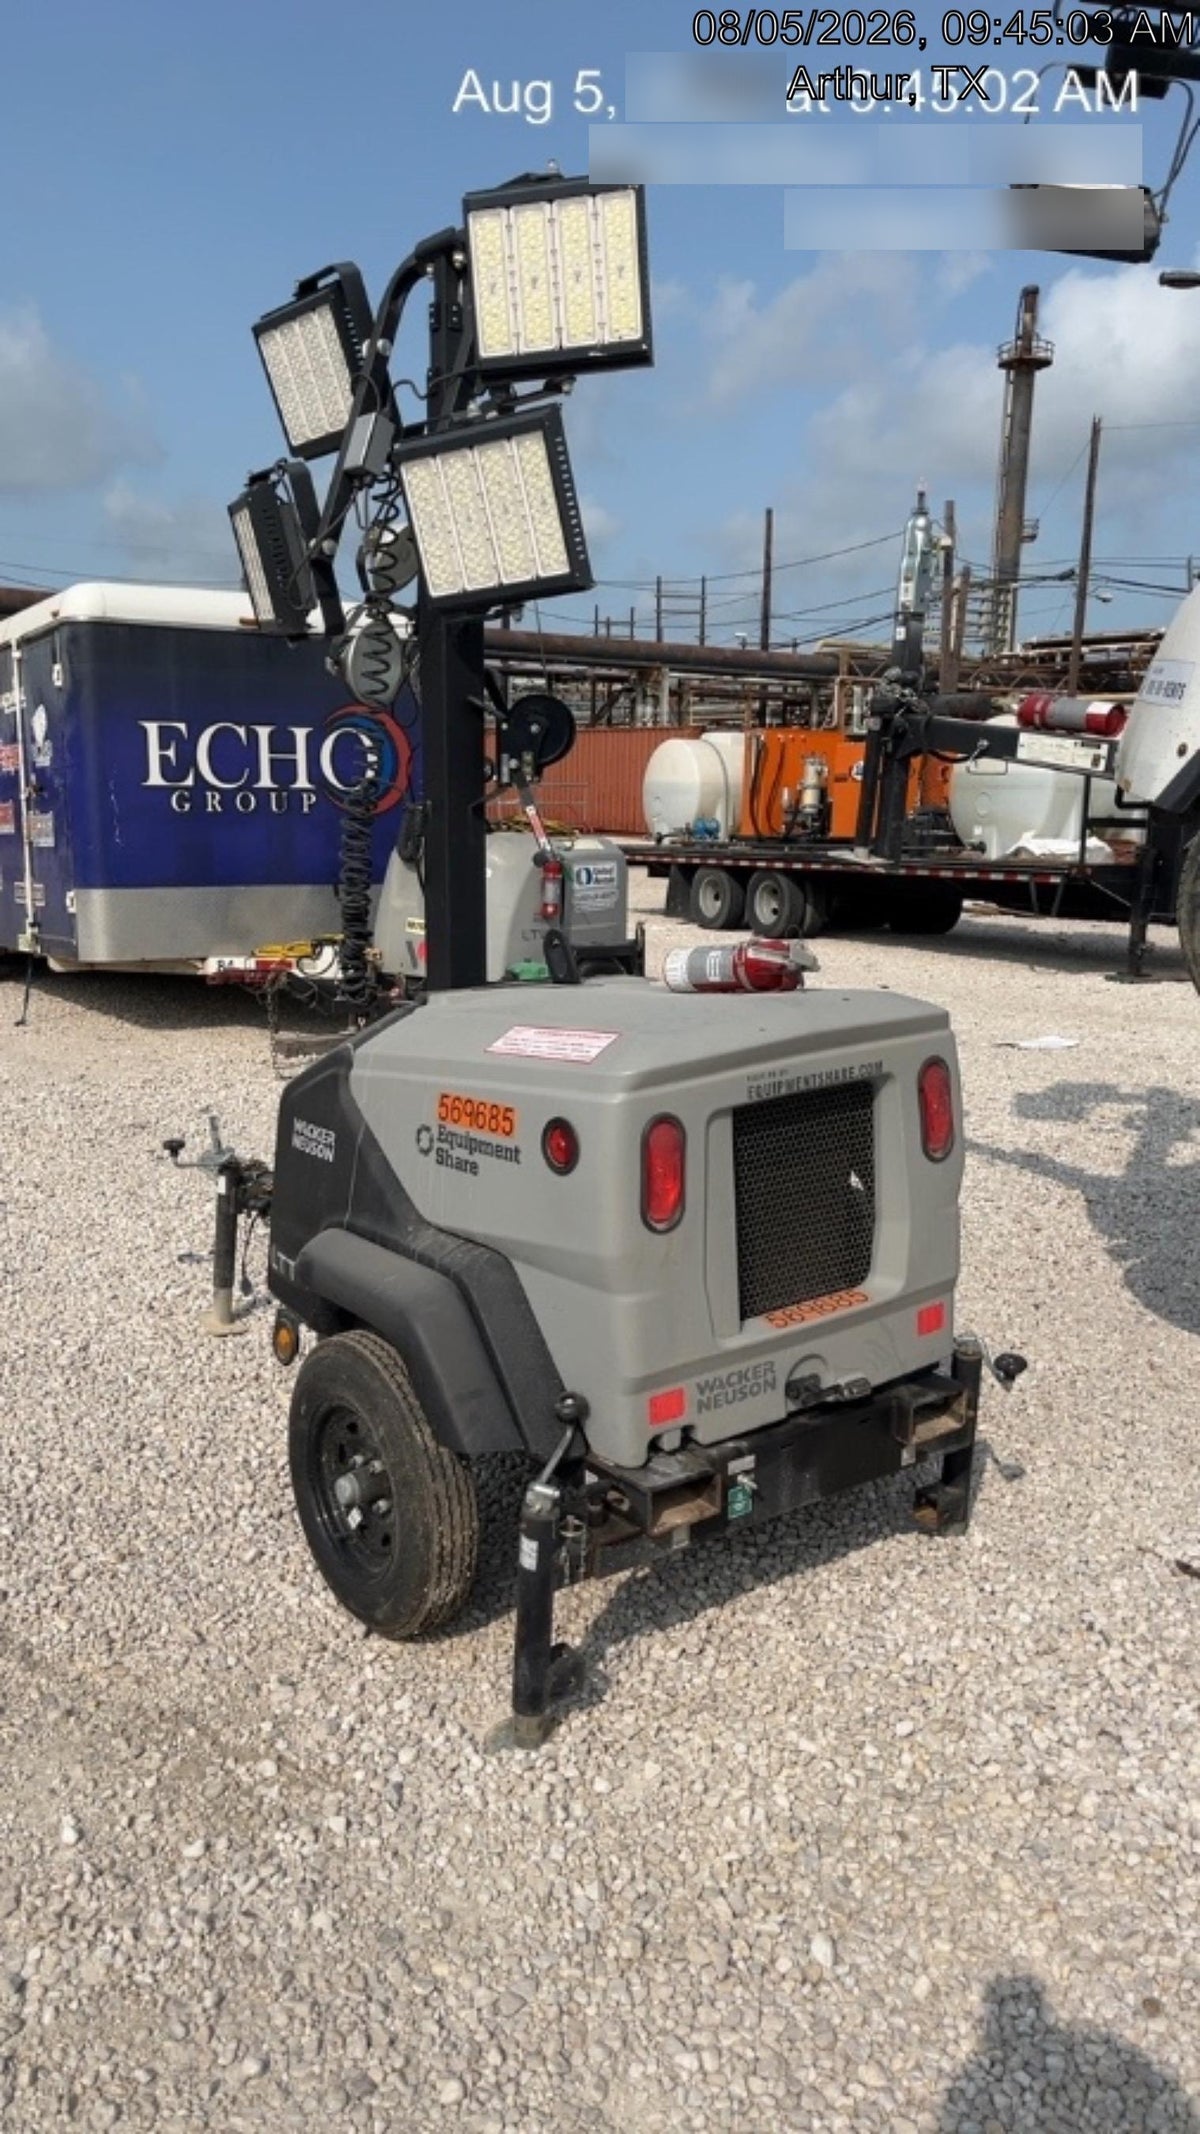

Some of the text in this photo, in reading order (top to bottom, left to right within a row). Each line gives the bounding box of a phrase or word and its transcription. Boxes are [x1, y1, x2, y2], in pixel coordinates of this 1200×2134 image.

[138, 720, 379, 791] ECHO
[170, 790, 316, 814] GROUP
[438, 1092, 515, 1136] 569685
[291, 1133, 335, 1162] NEUSON
[294, 1117, 335, 1147] WACKER
[437, 1124, 521, 1164] Equipment
[435, 1147, 478, 1176] Share
[696, 1361, 775, 1396] WACKER
[697, 1378, 776, 1414] NEUSON
